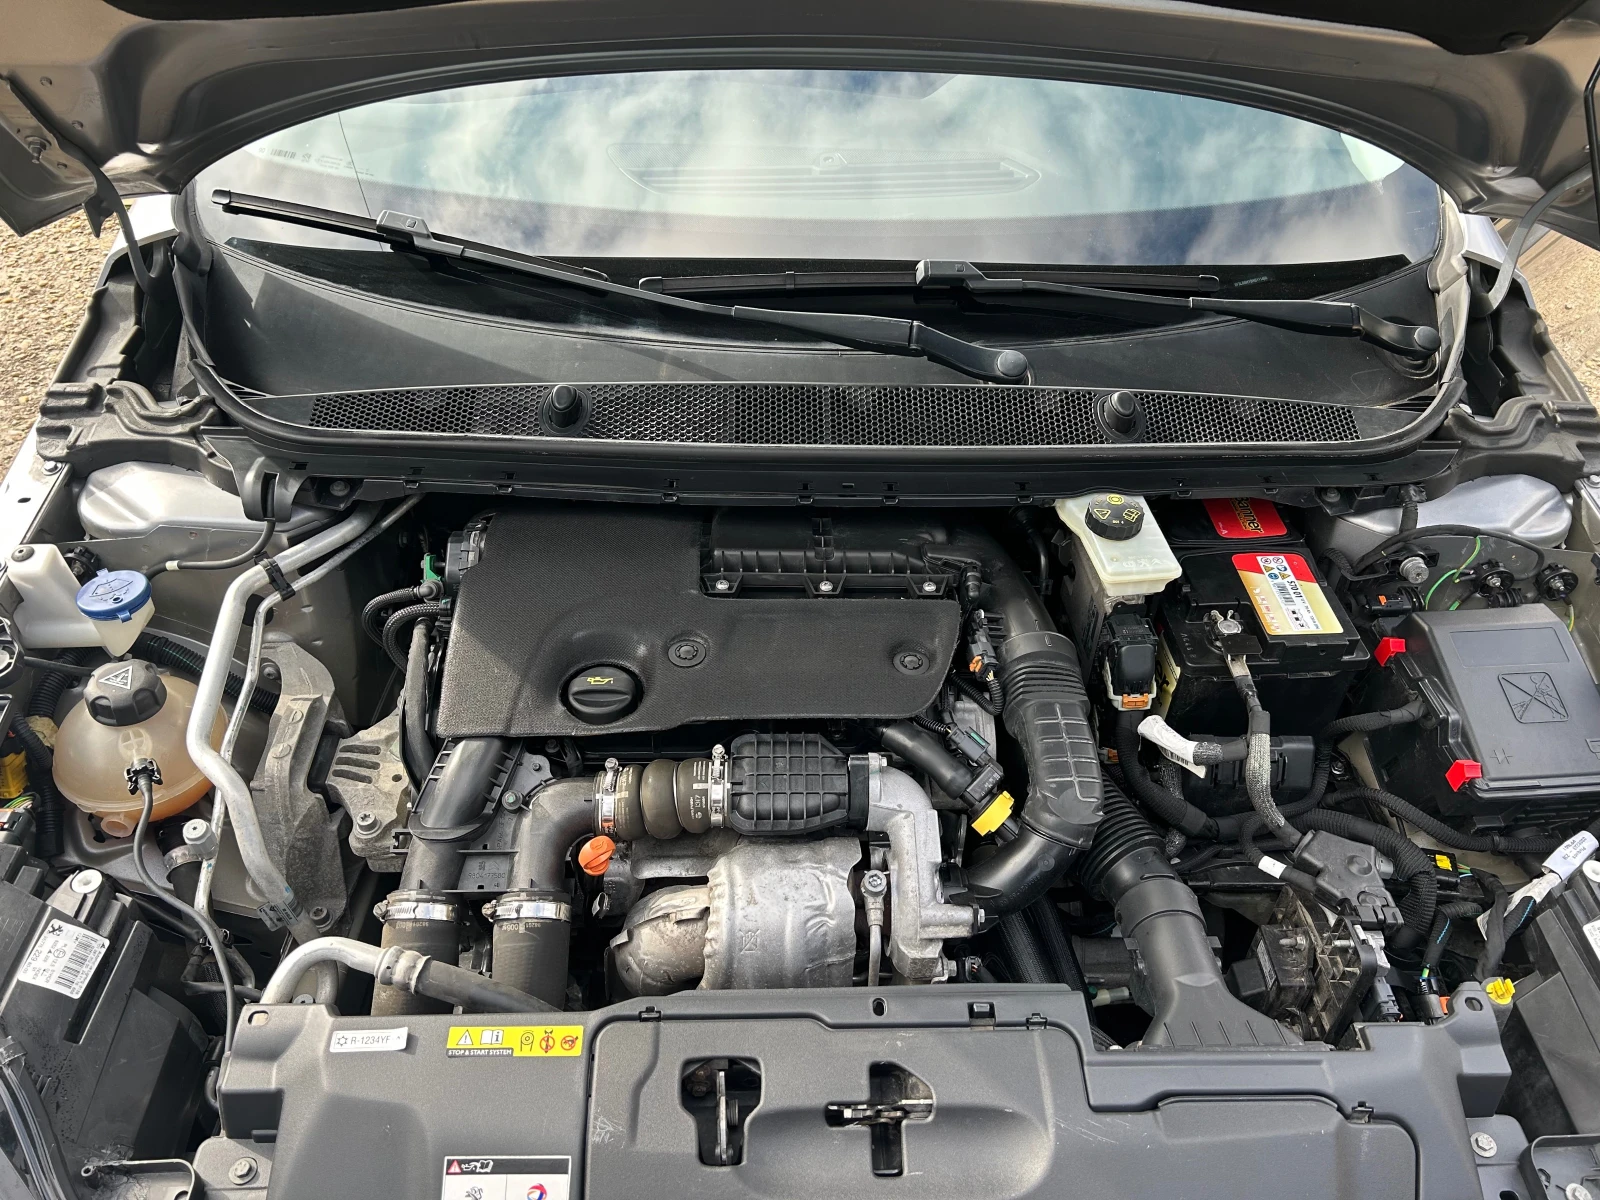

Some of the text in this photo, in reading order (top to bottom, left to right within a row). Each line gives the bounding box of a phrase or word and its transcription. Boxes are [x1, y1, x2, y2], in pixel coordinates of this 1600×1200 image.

[1235, 497, 1264, 533] Banner
[1287, 580, 1299, 592] 570
[1293, 591, 1303, 599] 01
[31, 949, 43, 962] 229
[350, 1035, 391, 1045] R-1234YF
